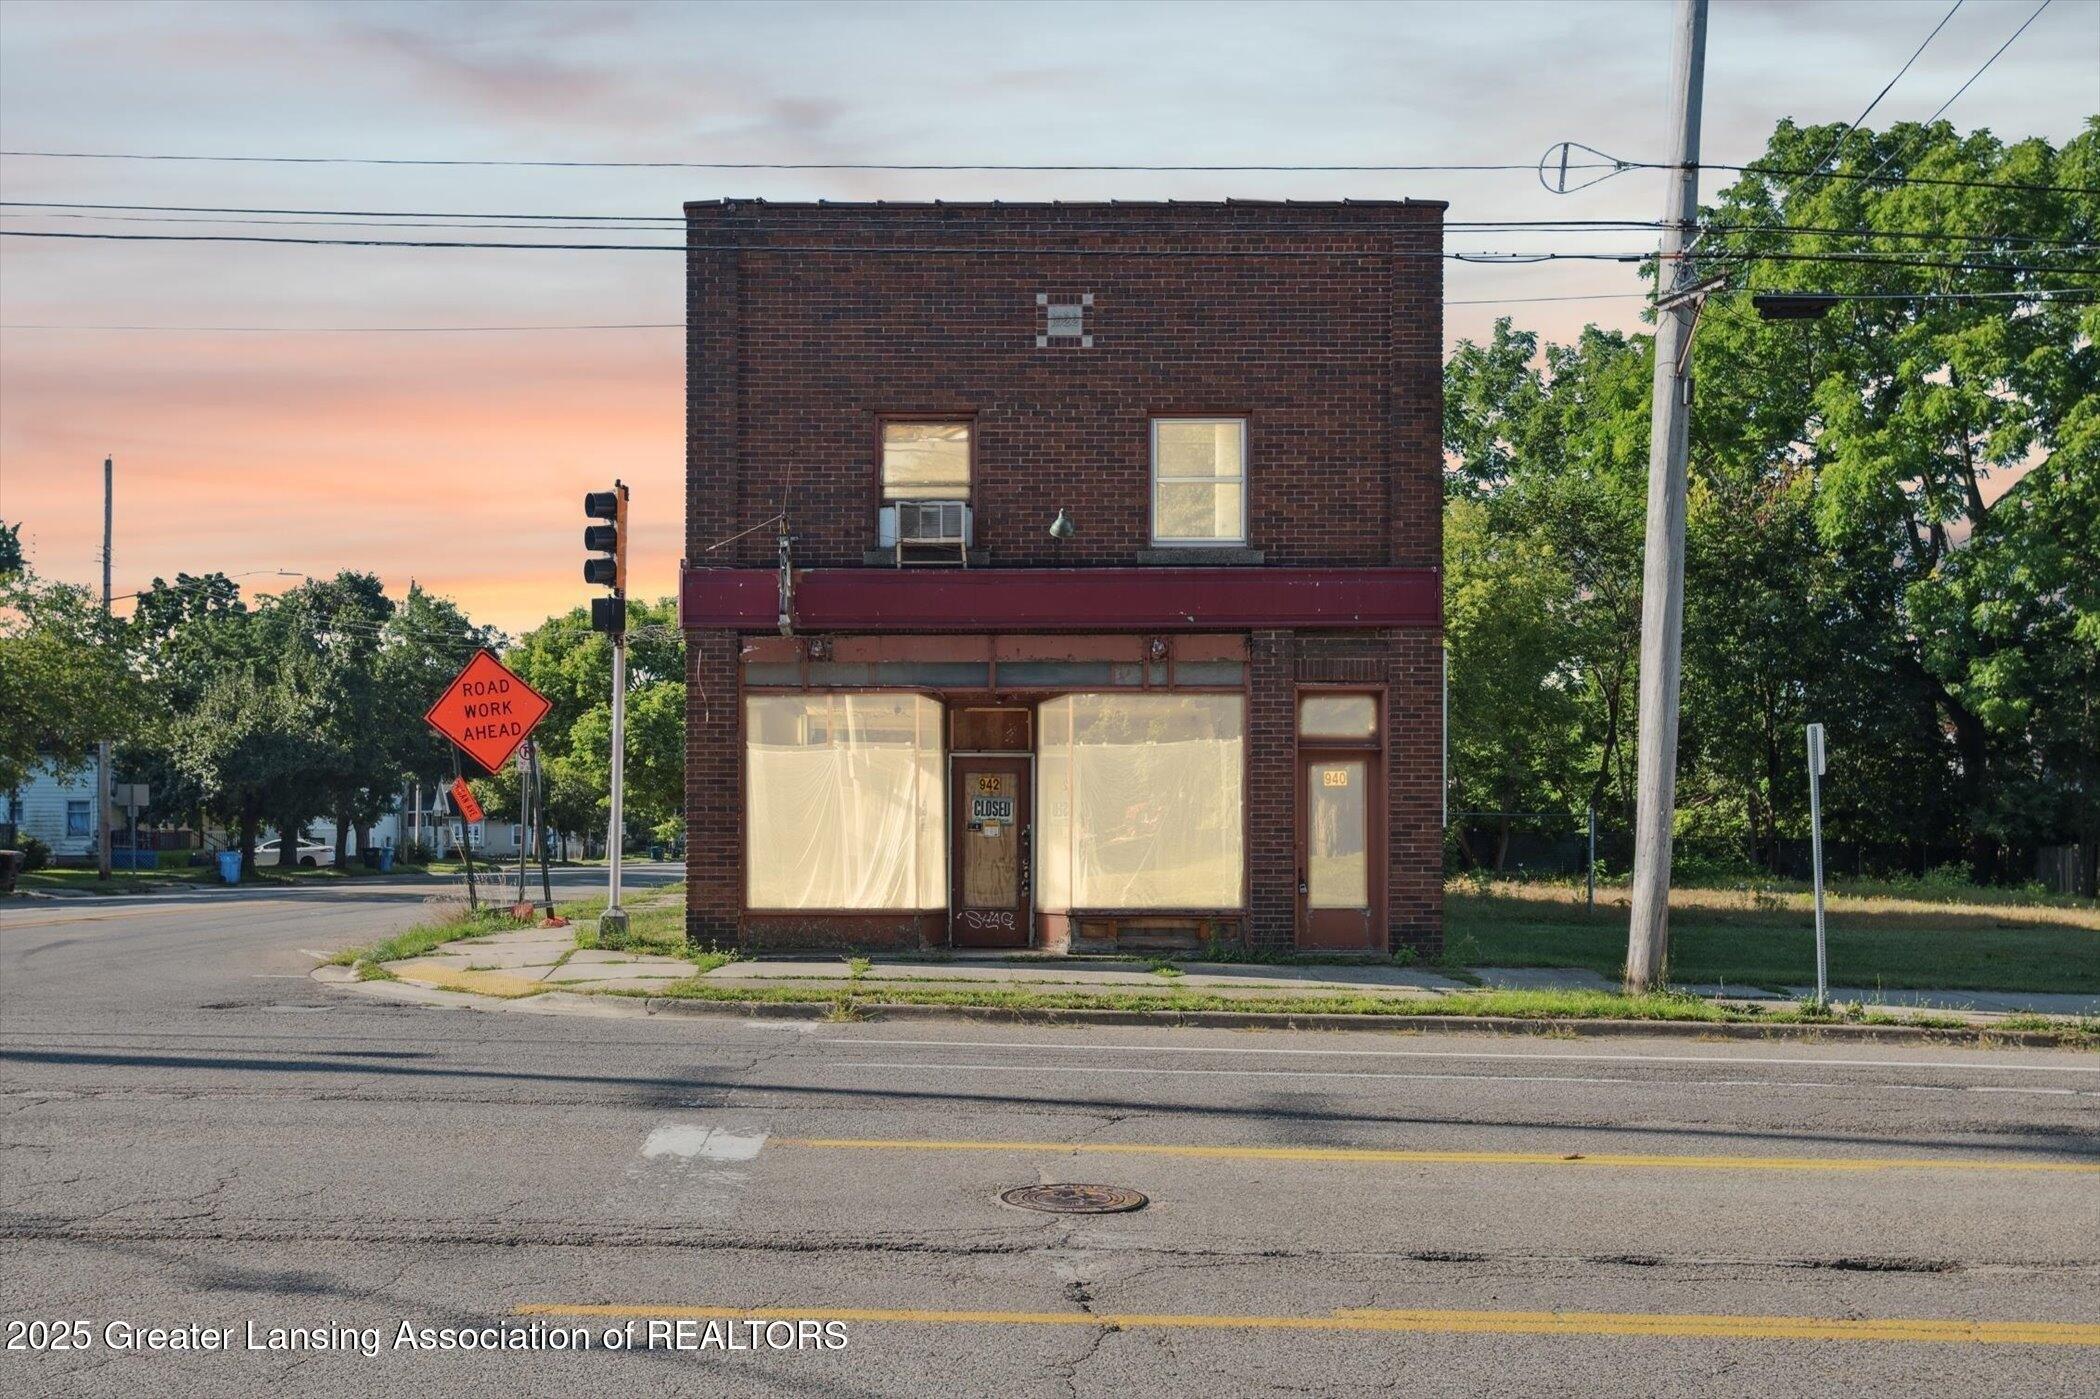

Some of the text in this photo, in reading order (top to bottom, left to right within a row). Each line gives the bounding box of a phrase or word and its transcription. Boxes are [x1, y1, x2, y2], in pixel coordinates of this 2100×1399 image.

[463, 679, 509, 697] ROAD
[464, 700, 512, 718] WORK
[464, 722, 521, 741] AHEAD
[979, 778, 1000, 791] 942
[1325, 772, 1345, 785] 940
[974, 800, 1011, 817] CLOSED
